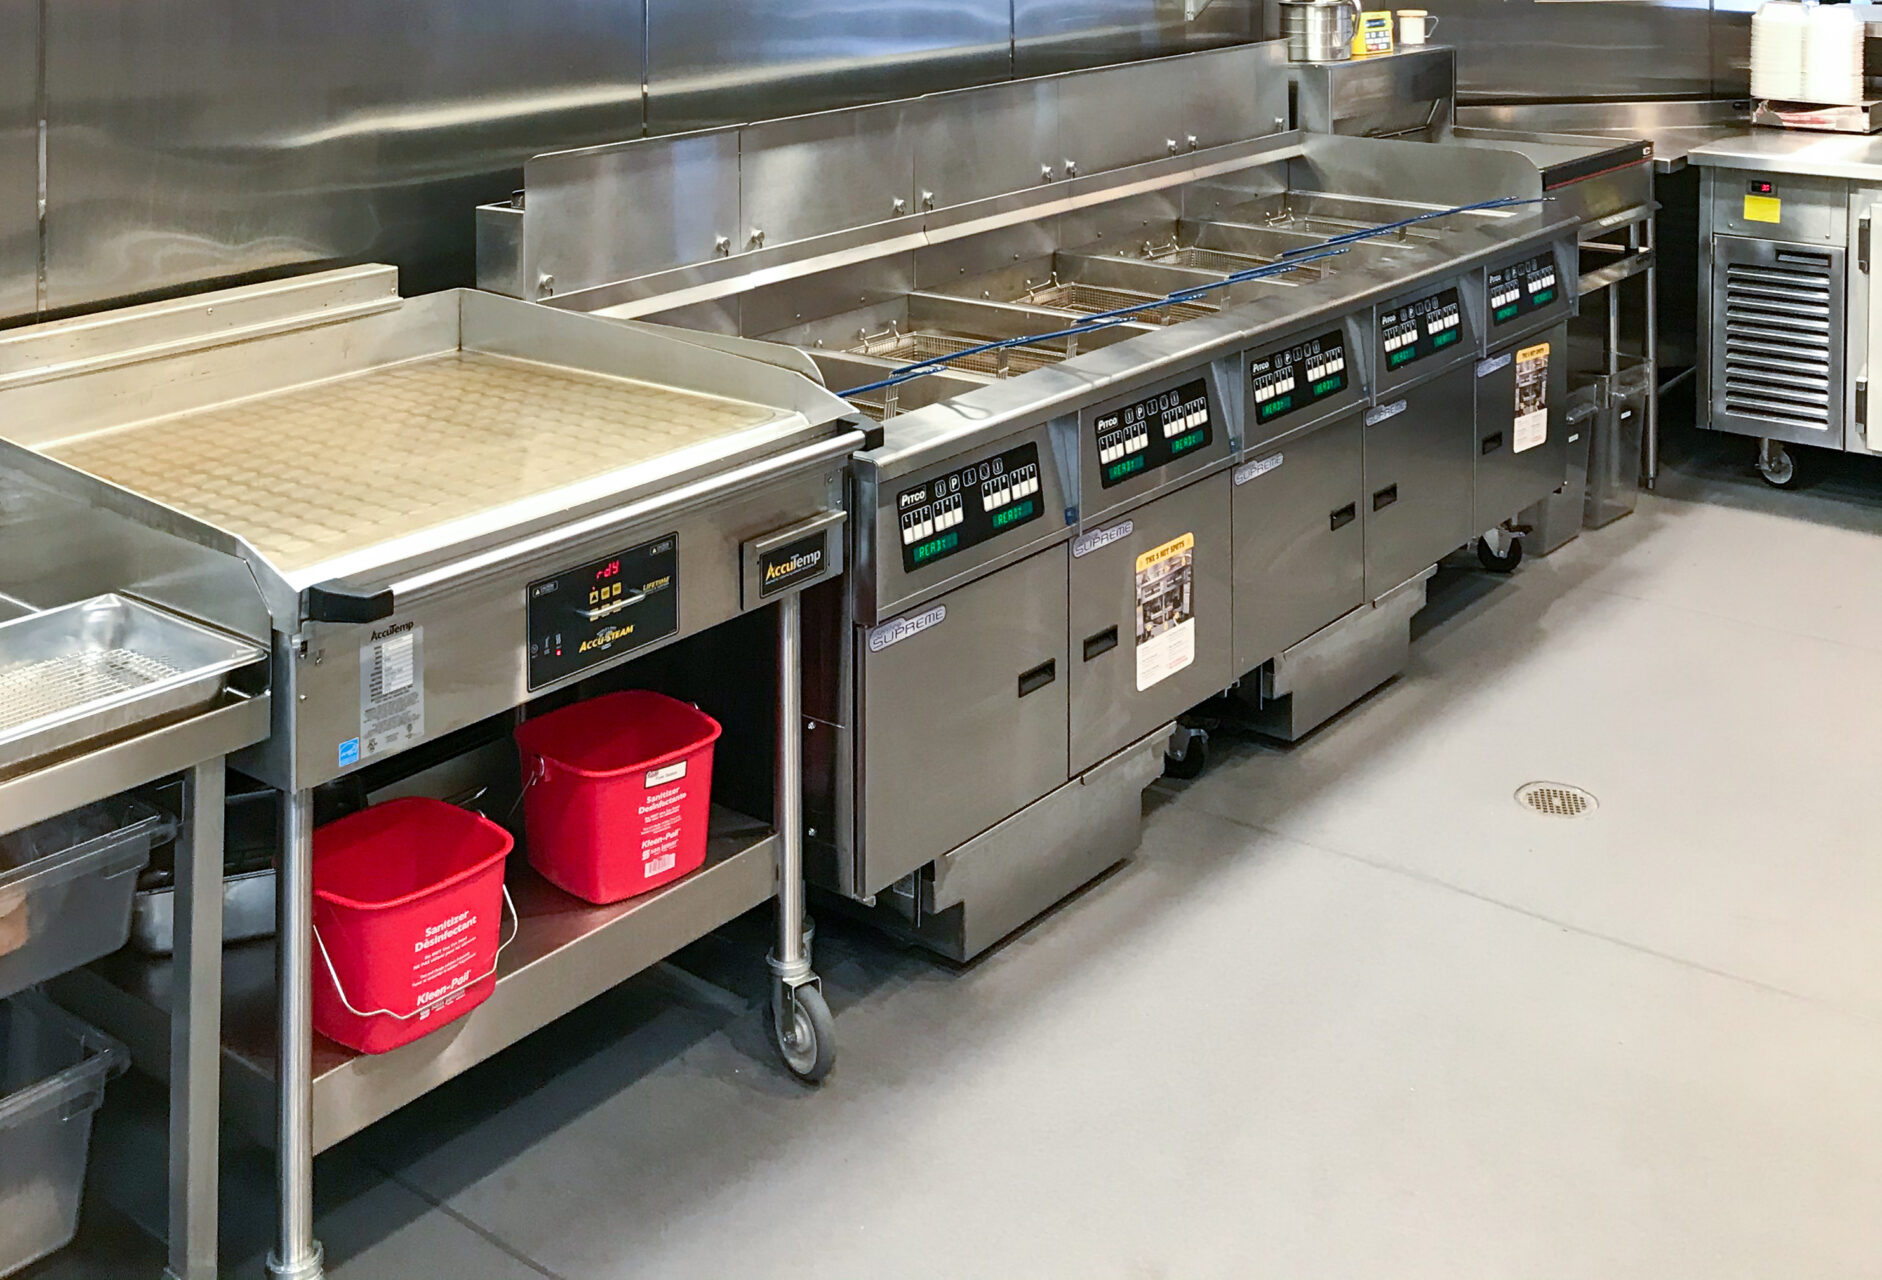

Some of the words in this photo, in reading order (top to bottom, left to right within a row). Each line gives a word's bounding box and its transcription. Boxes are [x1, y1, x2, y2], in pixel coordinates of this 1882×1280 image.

[1076, 523, 1131, 556] SUPREME
[766, 550, 821, 581] AccuTemp
[371, 621, 414, 641] AccuTemp
[873, 608, 943, 649] SUPREME
[647, 787, 680, 804] Sanitizer
[425, 910, 469, 937] Sanitizer
[416, 970, 471, 1006] Kleen-Pail
